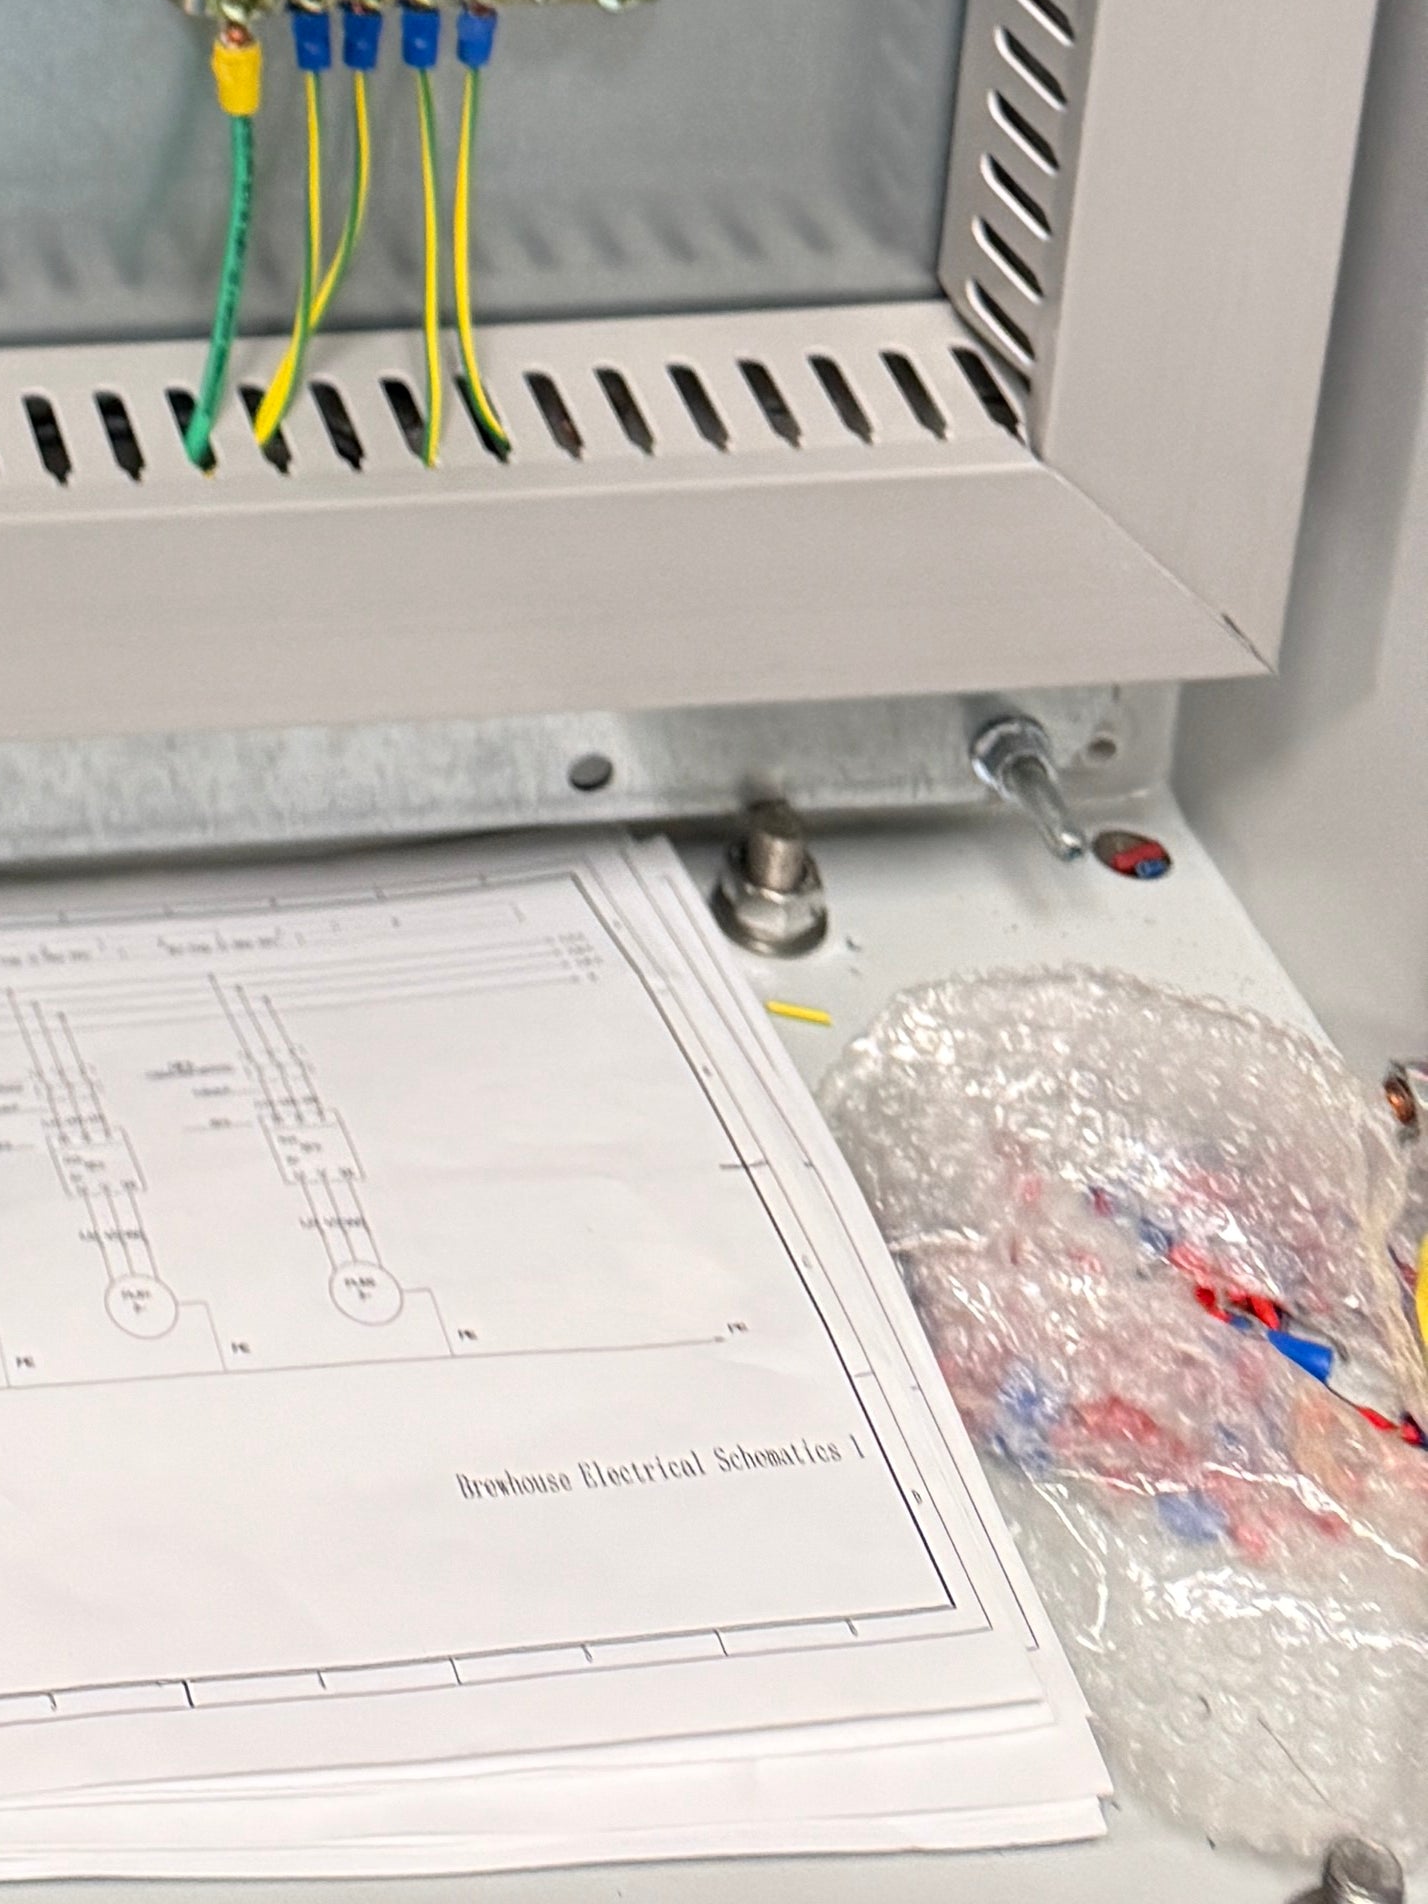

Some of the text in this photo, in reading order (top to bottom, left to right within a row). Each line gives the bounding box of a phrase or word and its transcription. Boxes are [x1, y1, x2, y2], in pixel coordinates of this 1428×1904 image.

[455, 1461, 573, 1501] Brewhouse
[577, 1449, 707, 1489] Electrical
[712, 1437, 843, 1473] Schematics
